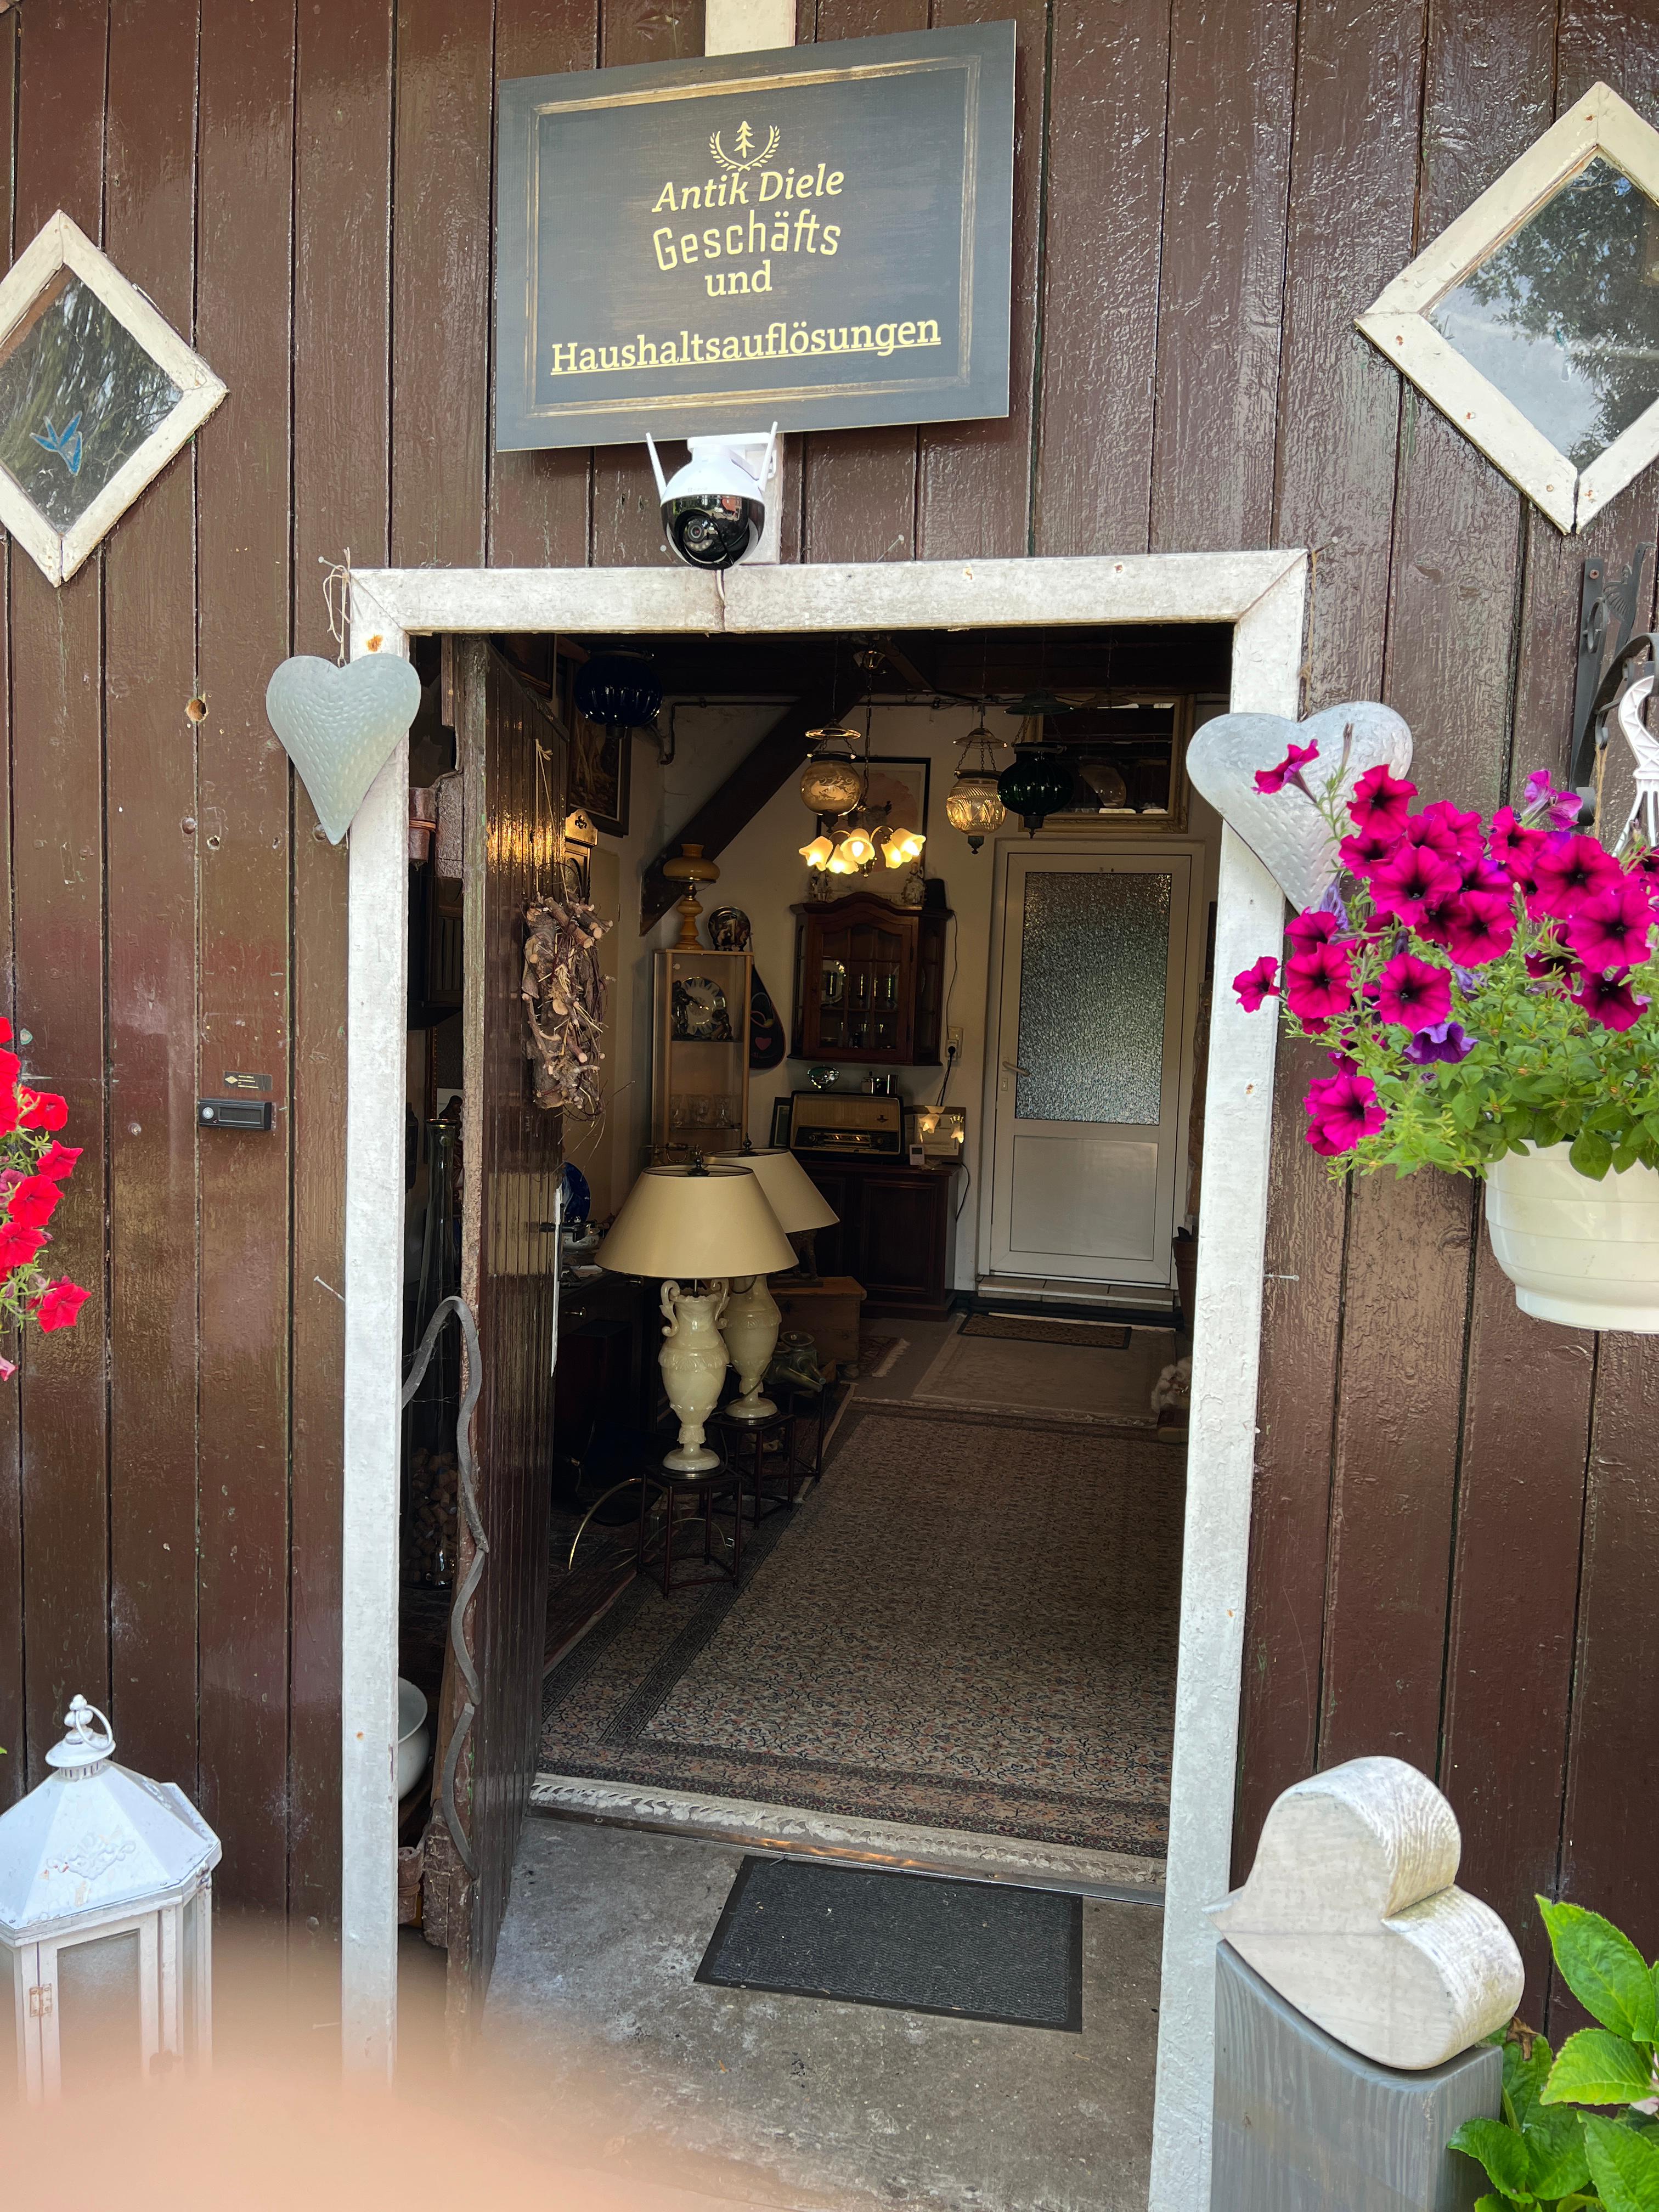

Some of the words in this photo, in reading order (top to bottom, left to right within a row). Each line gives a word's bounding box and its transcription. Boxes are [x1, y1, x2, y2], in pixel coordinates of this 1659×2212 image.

[650, 172, 749, 213] Antik
[759, 163, 844, 202] Diele
[653, 210, 840, 270] Geschäfts
[704, 260, 773, 297] und
[551, 319, 941, 376] Haushaltsauflösungen
